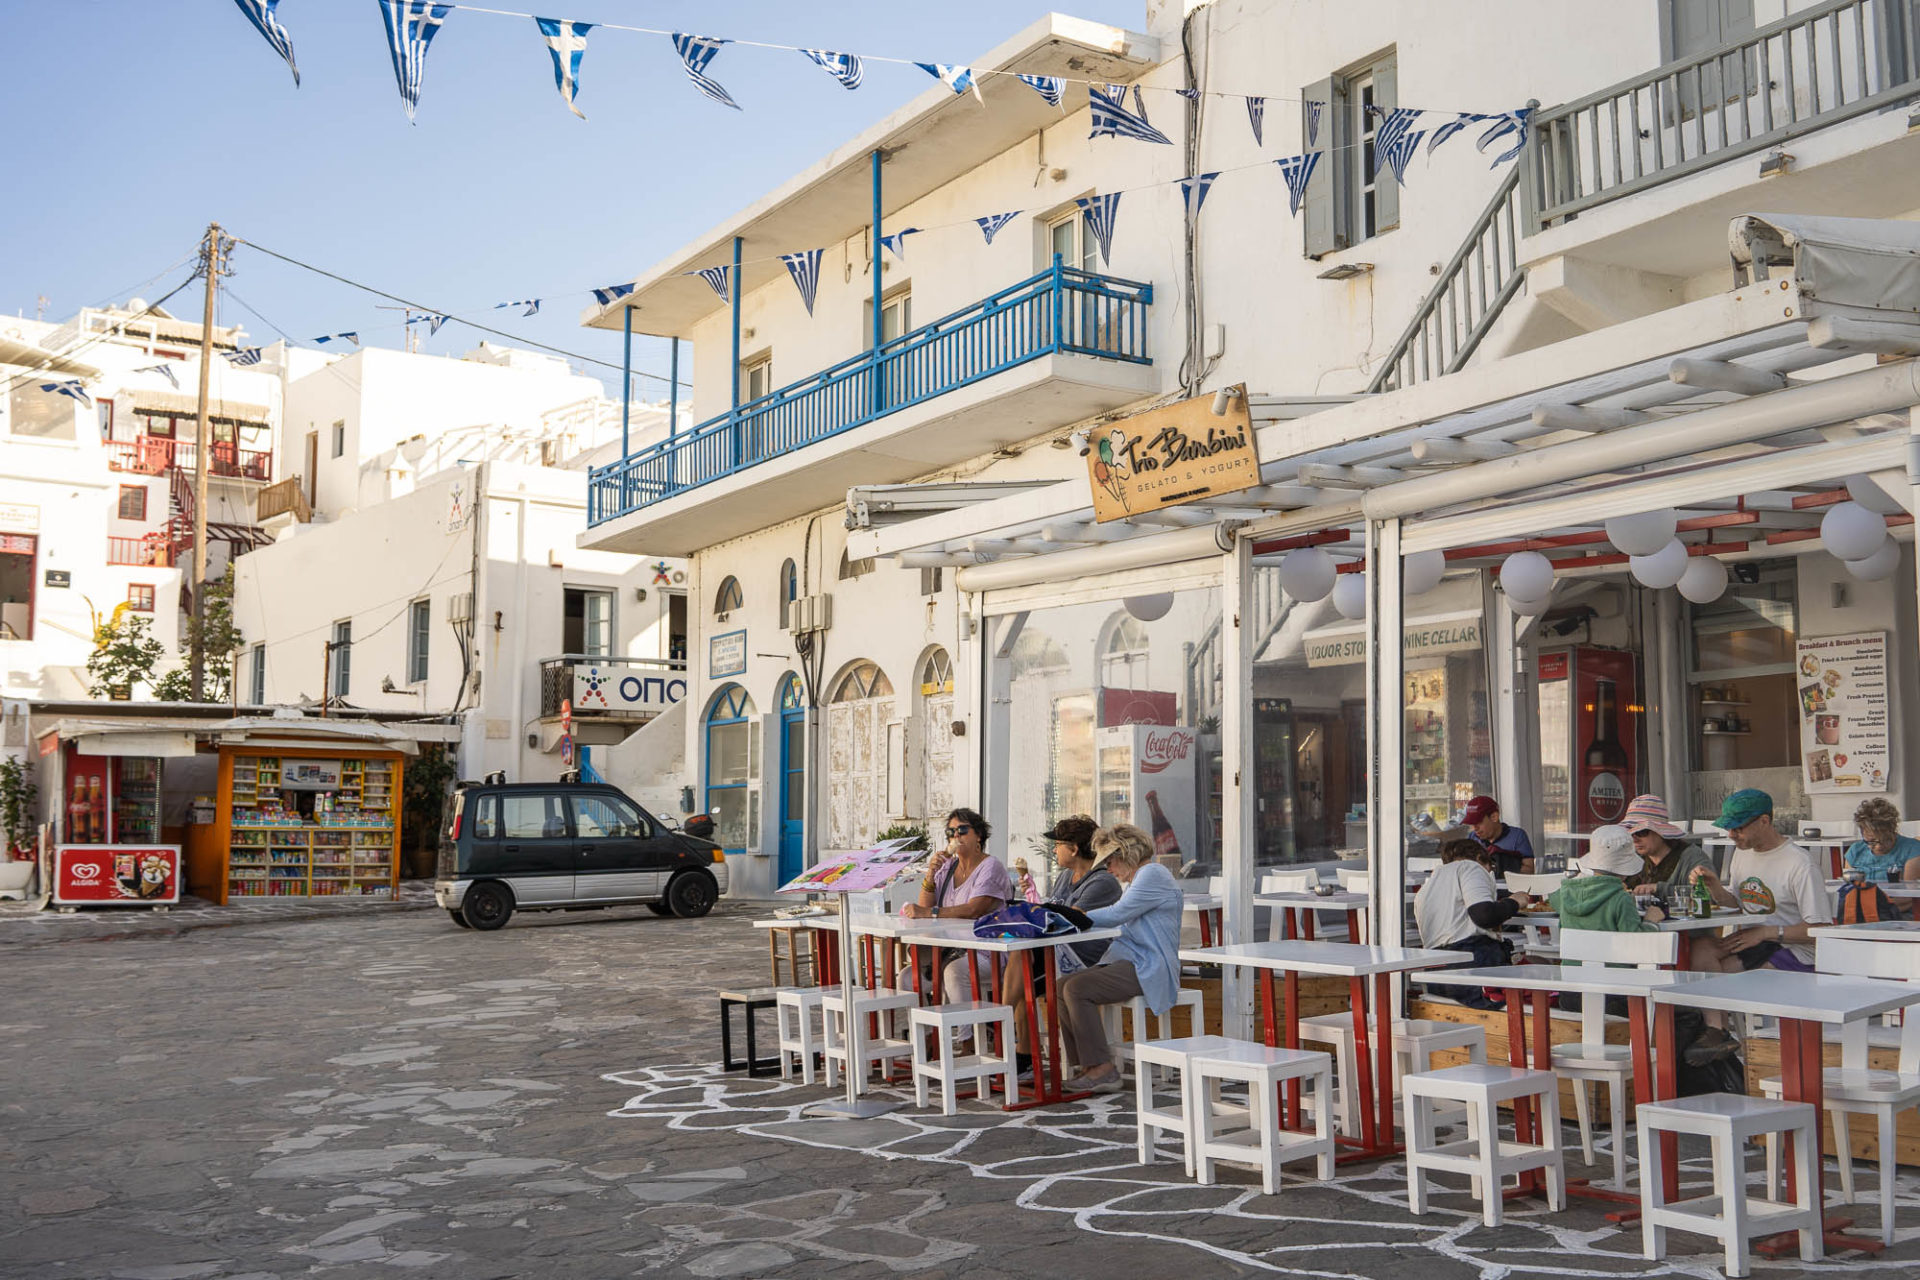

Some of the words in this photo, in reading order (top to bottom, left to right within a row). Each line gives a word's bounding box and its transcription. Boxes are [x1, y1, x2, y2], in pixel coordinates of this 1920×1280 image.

[1119, 435, 1158, 475] Trio
[1147, 425, 1247, 470] Bambini
[1137, 475, 1178, 493] GELATO
[1186, 471, 1193, 480] &
[1201, 457, 1250, 476] YOGURT
[1430, 626, 1477, 645] CELLAR
[1798, 641, 1828, 650] Breakfast
[1836, 638, 1861, 647] Brunch
[1343, 640, 1366, 657] STO
